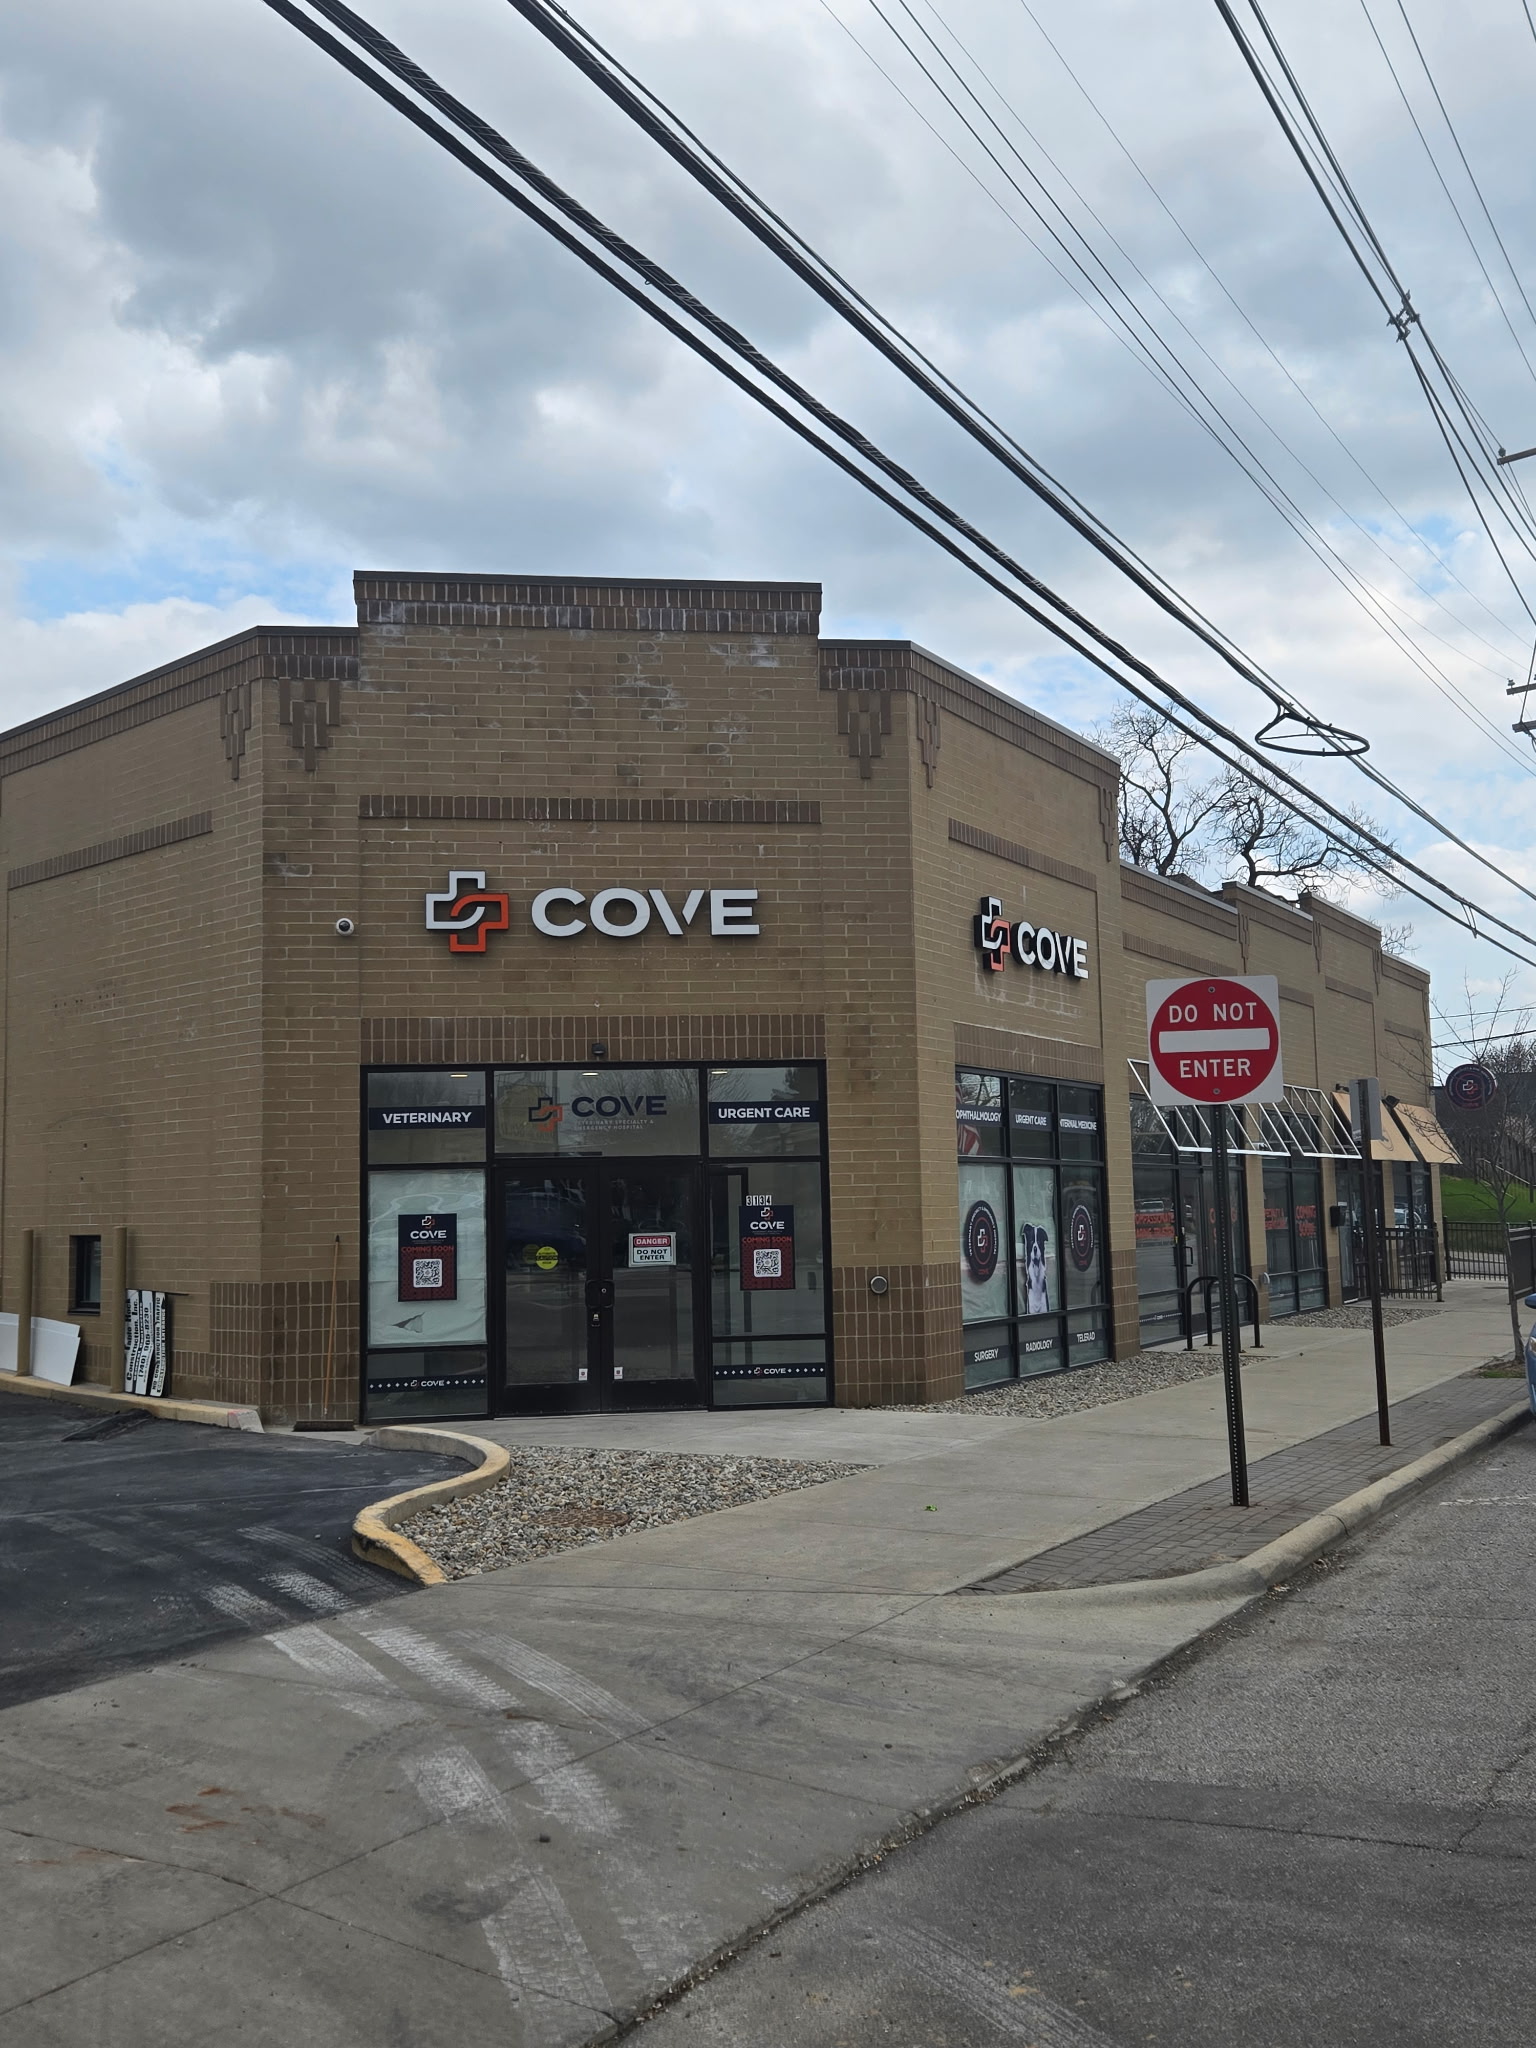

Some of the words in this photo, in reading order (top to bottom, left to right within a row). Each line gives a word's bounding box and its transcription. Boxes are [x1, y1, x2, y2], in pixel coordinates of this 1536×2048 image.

[531, 887, 760, 937] COVE
[1016, 921, 1089, 979] COVE
[1169, 1004, 1198, 1023] DO
[1213, 1002, 1257, 1021] NOT
[1180, 1058, 1251, 1078] ENTER
[571, 1095, 667, 1117] COVE
[718, 1107, 772, 1119] URGENT
[774, 1106, 811, 1118] CARE
[382, 1111, 472, 1124] VETERINARY
[955, 1109, 1001, 1122] OPHTHALMOLOGY
[1015, 1114, 1034, 1125] URGENT
[1034, 1115, 1047, 1126] CARE
[1060, 1119, 1079, 1128] NTERNAL
[746, 1195, 772, 1206] 3134
[750, 1221, 785, 1230] COVE
[410, 1230, 447, 1239] COVE
[131, 1298, 139, 1316] Inc.
[1077, 1331, 1096, 1343] TELERAD
[1025, 1339, 1053, 1352] RADIOLOGY
[974, 1348, 999, 1362] SURGERY
